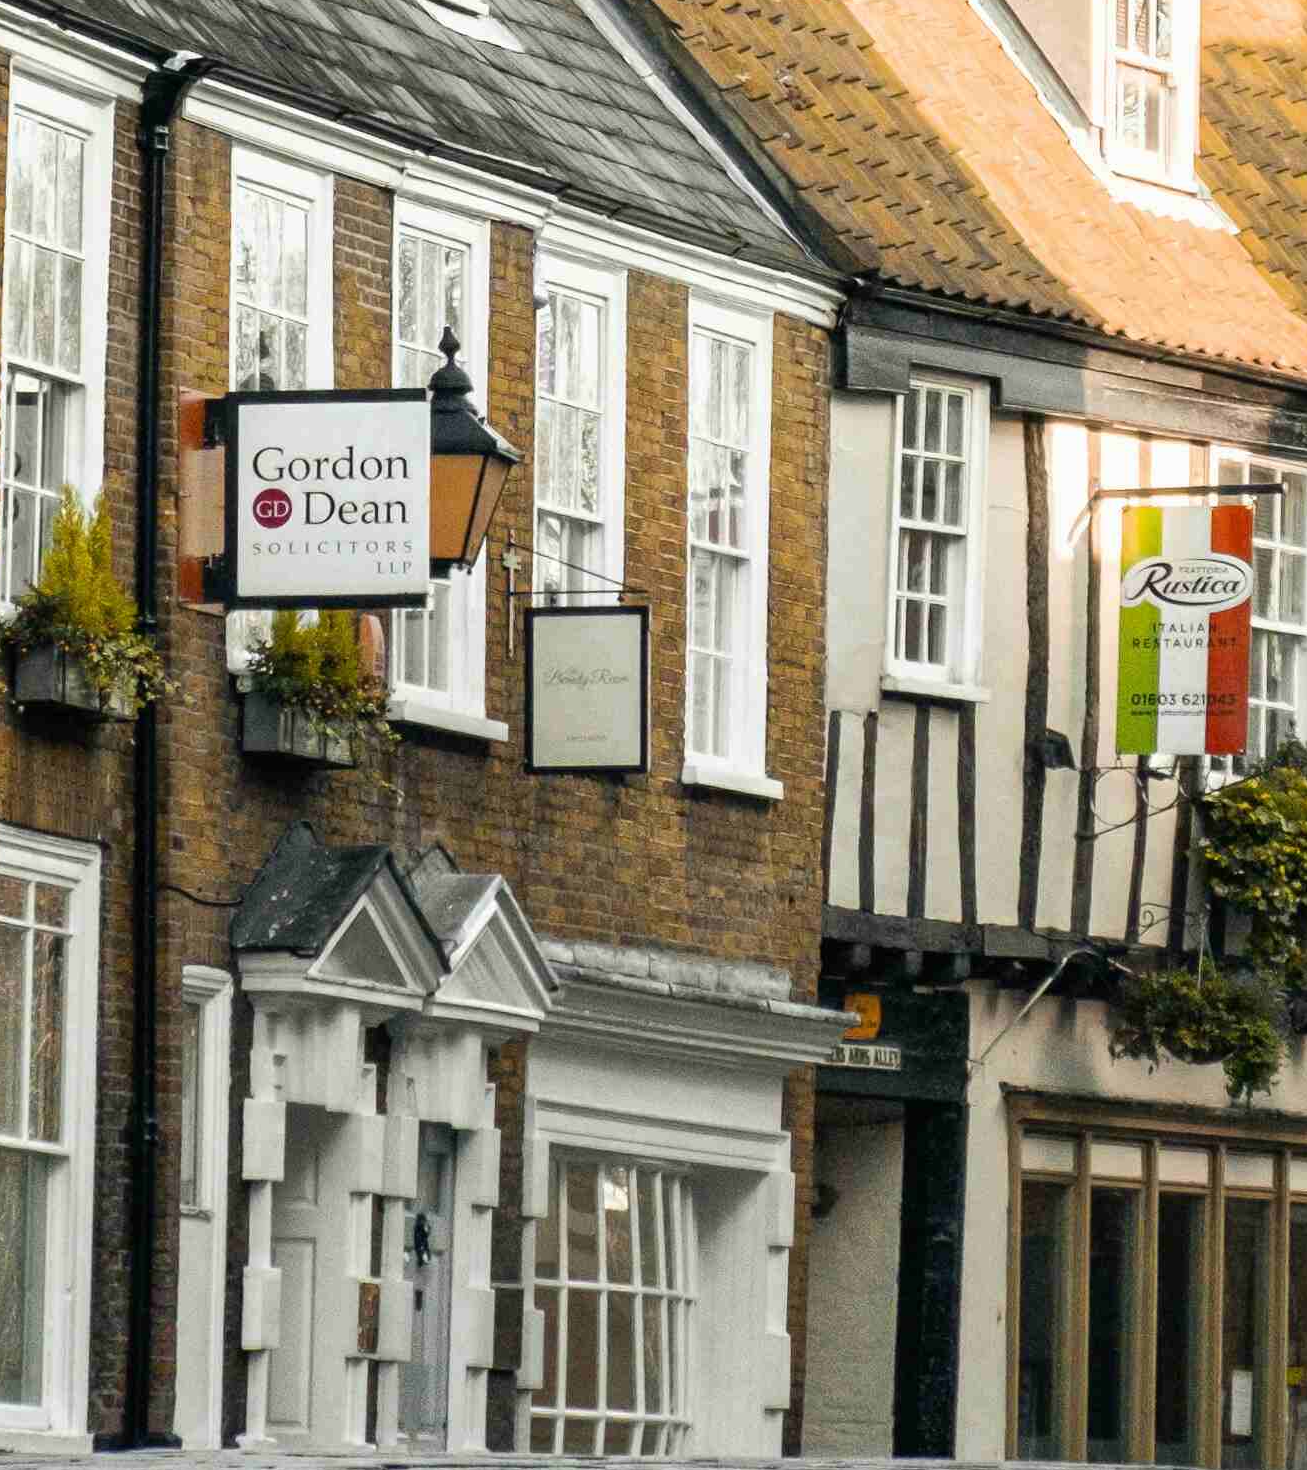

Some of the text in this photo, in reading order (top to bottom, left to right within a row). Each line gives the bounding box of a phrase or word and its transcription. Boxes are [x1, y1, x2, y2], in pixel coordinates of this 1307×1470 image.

[252, 446, 412, 482] Gordon
[255, 500, 290, 518] GD
[303, 491, 410, 526] Dean
[252, 540, 413, 556] SOLICITORS
[376, 561, 412, 574] LLP
[1126, 562, 1241, 601] Rustica
[1152, 621, 1218, 634] ITALIAN
[1132, 637, 1237, 650] RESTAURANT
